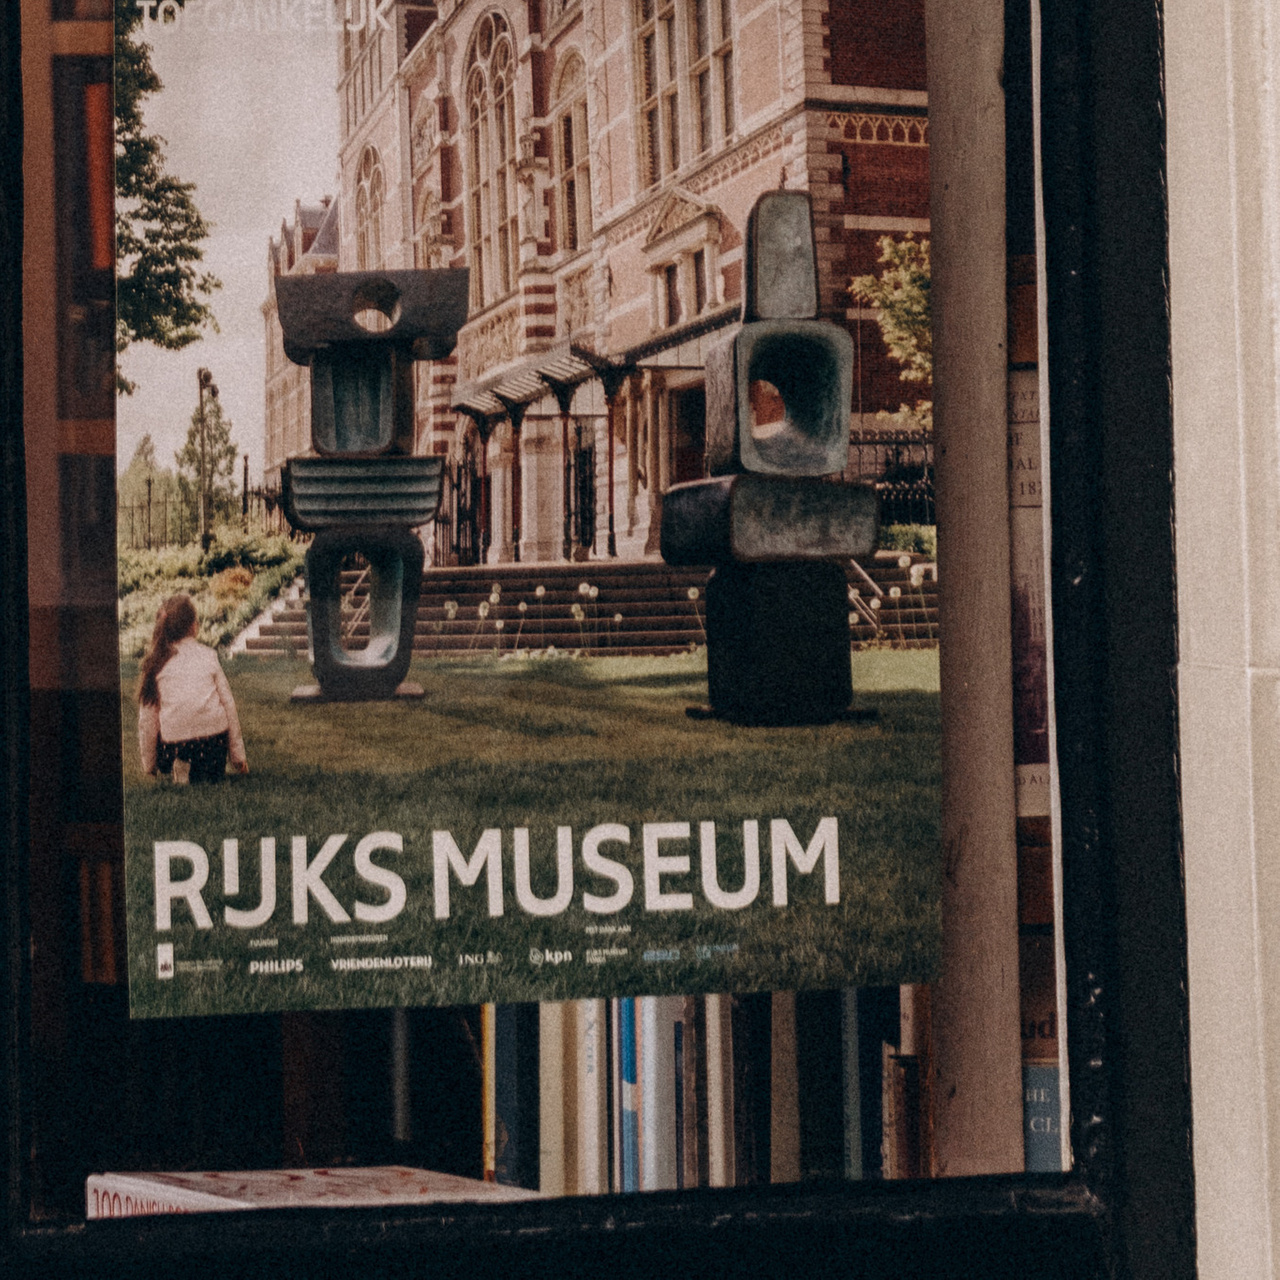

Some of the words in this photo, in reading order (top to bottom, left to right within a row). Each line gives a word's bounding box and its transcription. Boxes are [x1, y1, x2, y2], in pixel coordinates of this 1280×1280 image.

[154, 831, 408, 930] RIJKS
[432, 816, 841, 920] MUSEUM
[330, 955, 433, 972] VRIENDENLOTERIJ
[459, 953, 485, 966] ING
[544, 948, 573, 964] kpn
[249, 958, 304, 975] PHILIPS
